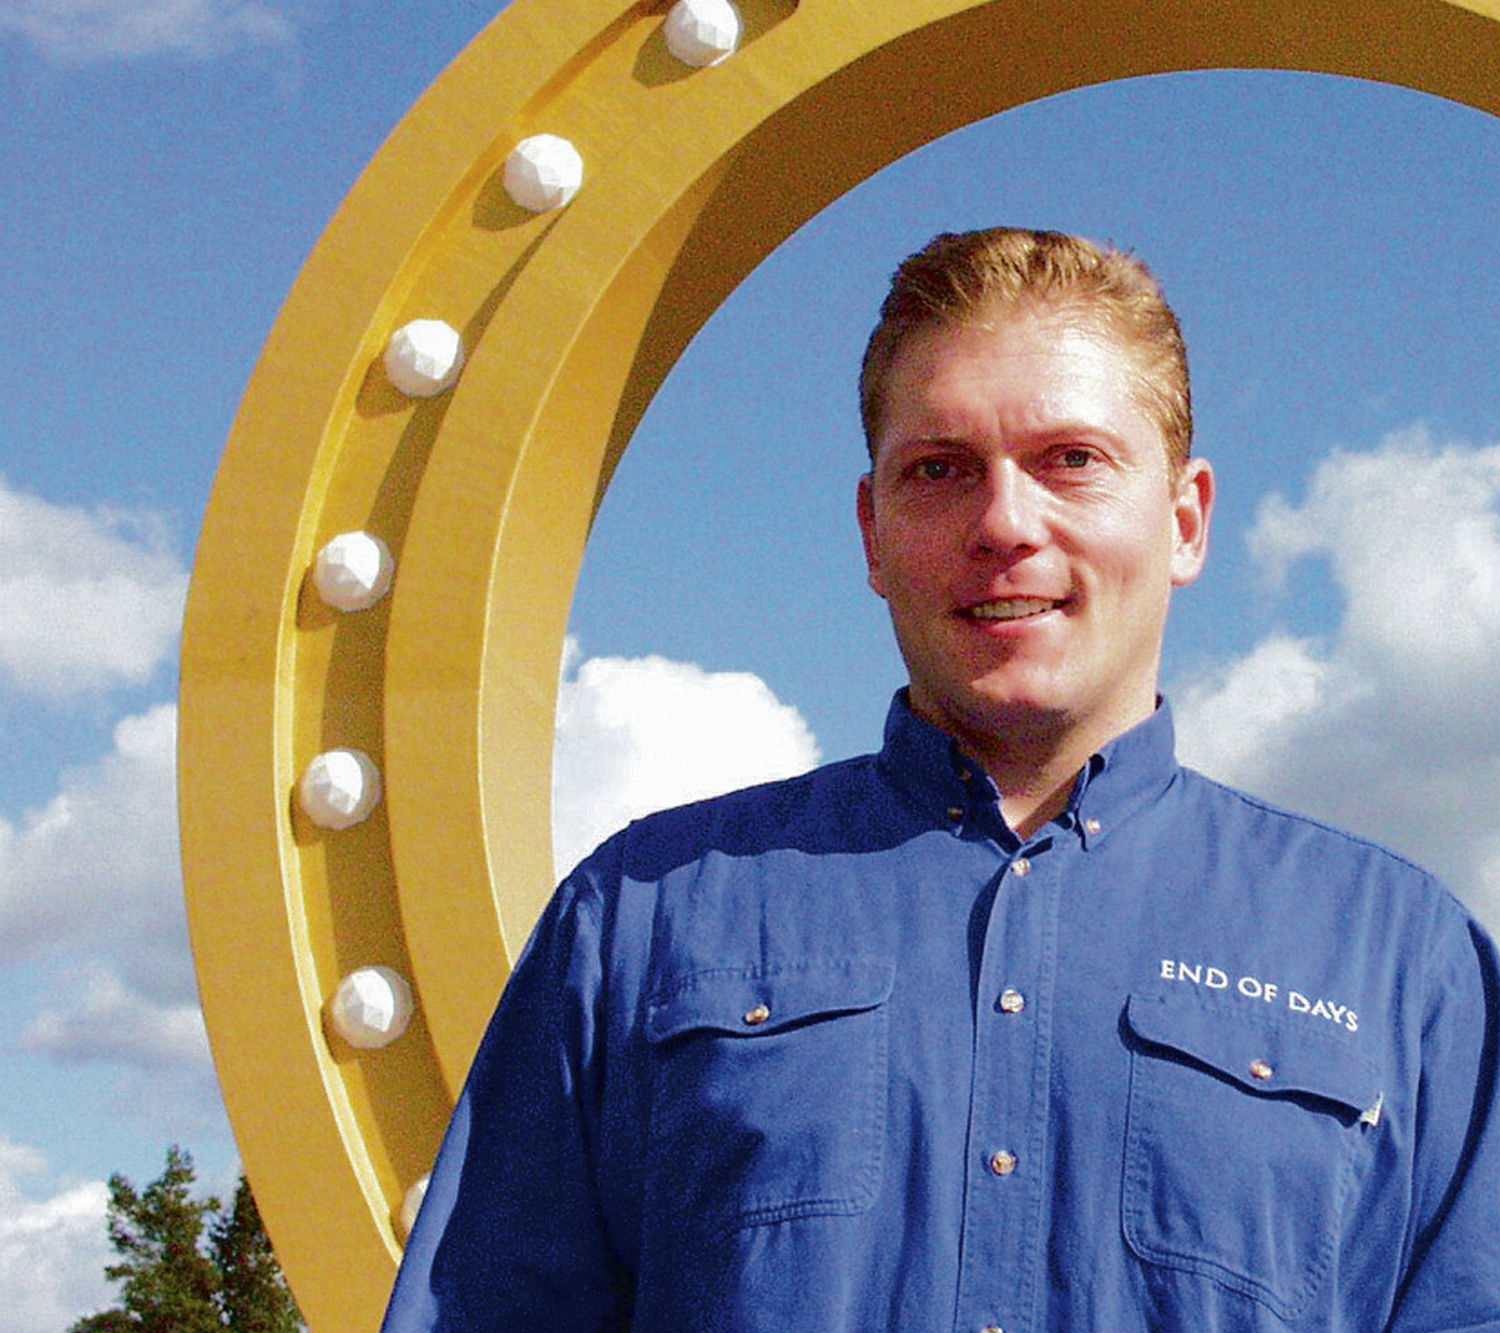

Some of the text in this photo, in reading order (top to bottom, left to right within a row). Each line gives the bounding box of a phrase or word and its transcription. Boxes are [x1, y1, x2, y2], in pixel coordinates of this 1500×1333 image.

[1161, 959, 1359, 1032] END OF DAYS
